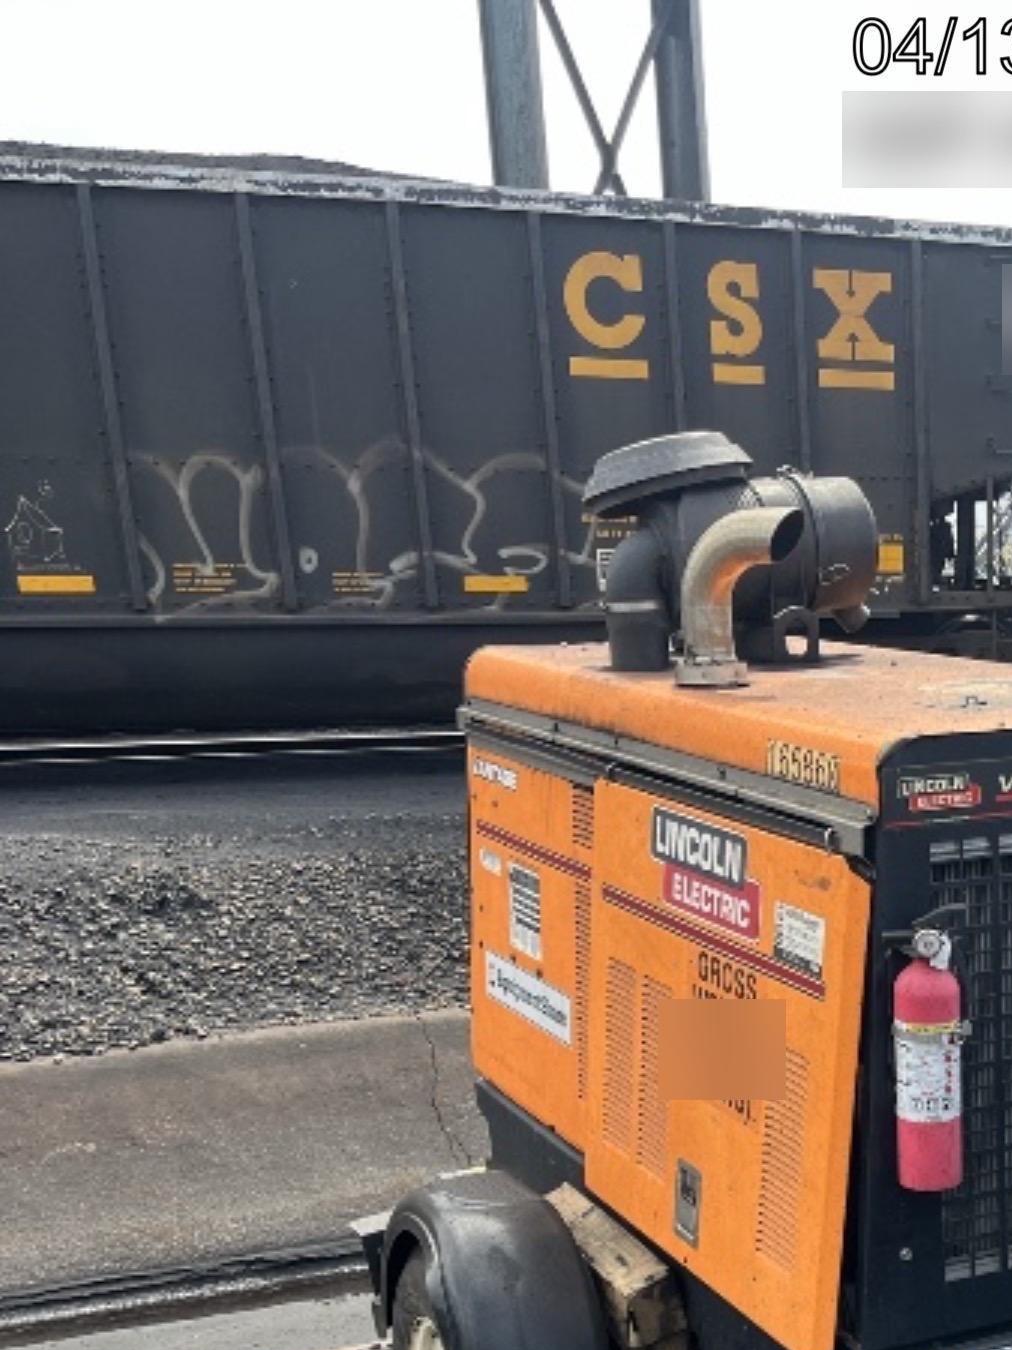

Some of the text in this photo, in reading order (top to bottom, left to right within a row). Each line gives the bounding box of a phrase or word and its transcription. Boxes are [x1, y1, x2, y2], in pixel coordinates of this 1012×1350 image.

[563, 250, 895, 363] CSX
[656, 815, 742, 884] LINCOLN
[672, 872, 751, 928] ELECTRIC
